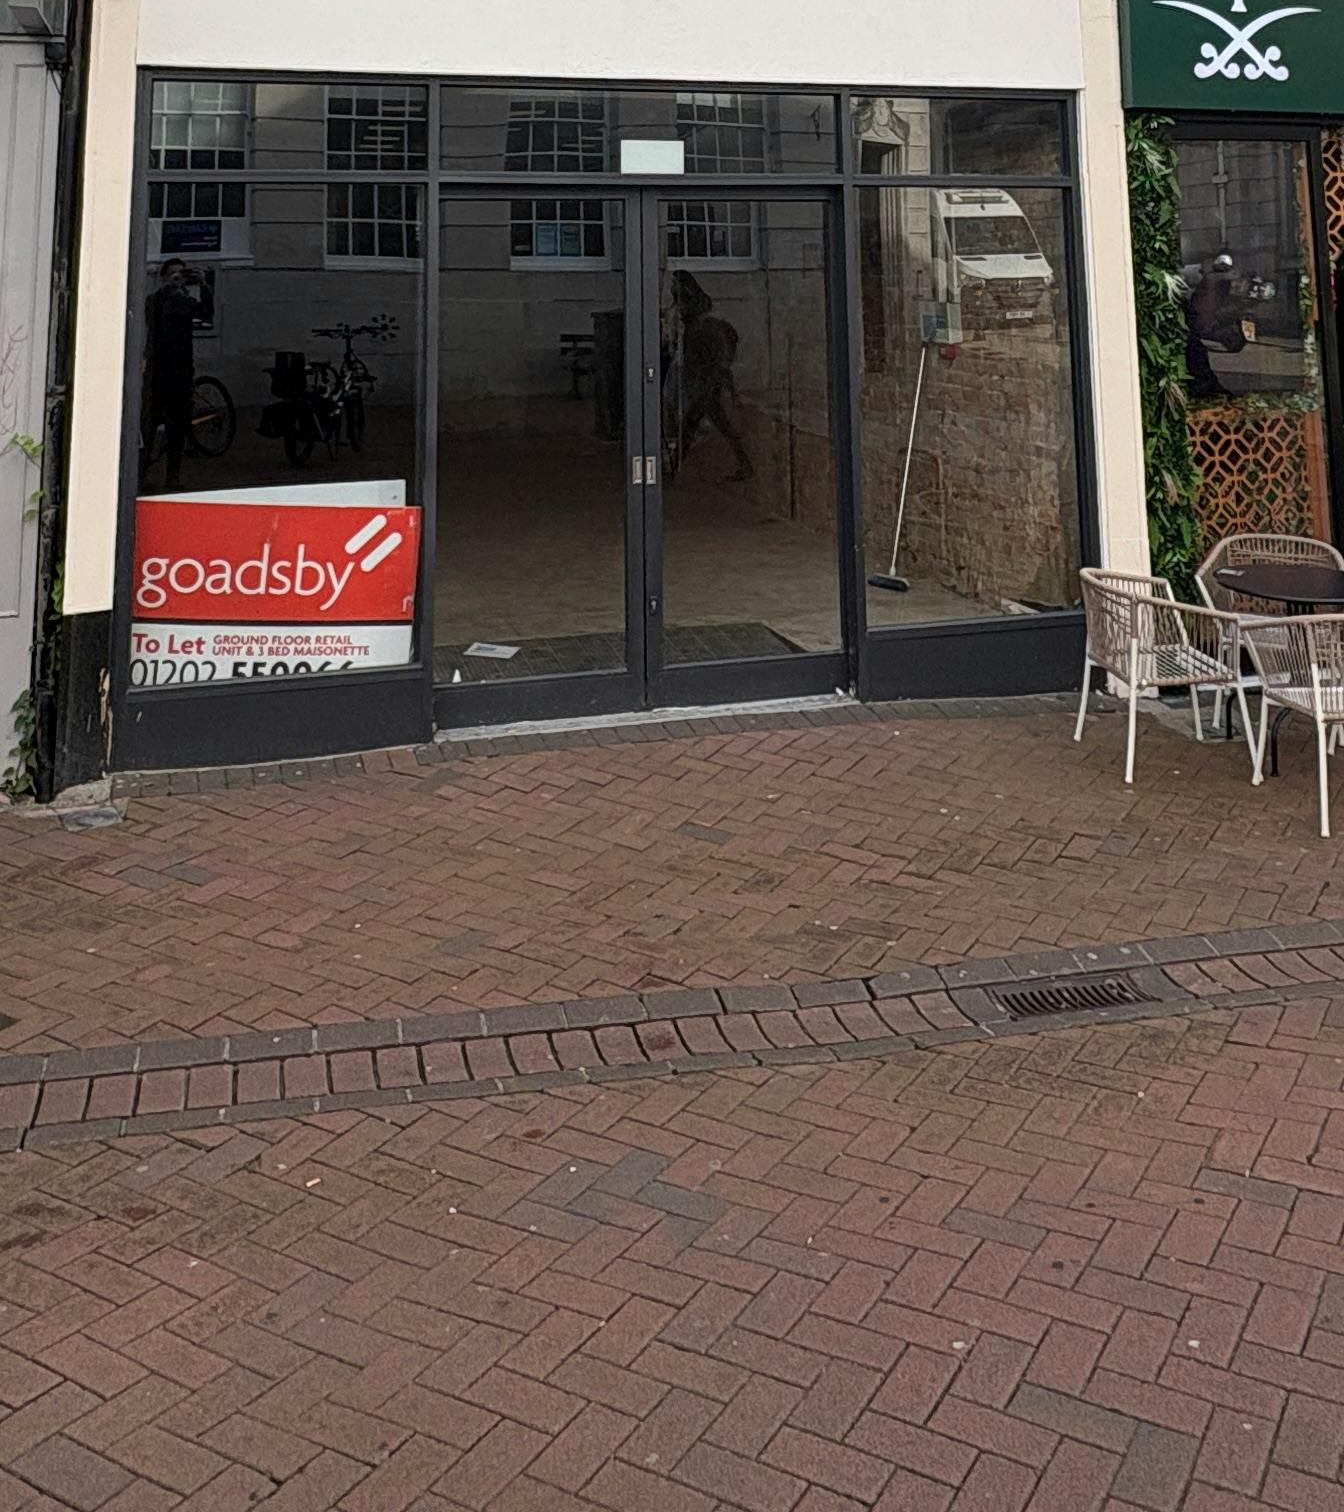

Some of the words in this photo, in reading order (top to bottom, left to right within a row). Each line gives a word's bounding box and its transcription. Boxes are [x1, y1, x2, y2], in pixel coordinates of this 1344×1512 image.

[136, 541, 355, 611] goadsby
[131, 632, 160, 654] To
[167, 633, 207, 656] Let
[212, 645, 242, 657] UNIT
[245, 645, 255, 656] &
[258, 646, 265, 656] 3
[268, 646, 291, 656] BED
[293, 645, 370, 657] MAISONETTE
[213, 634, 269, 646] GROUND
[271, 635, 312, 646] FLOOR
[315, 635, 354, 646] RETAIL
[129, 658, 217, 687] 01202
